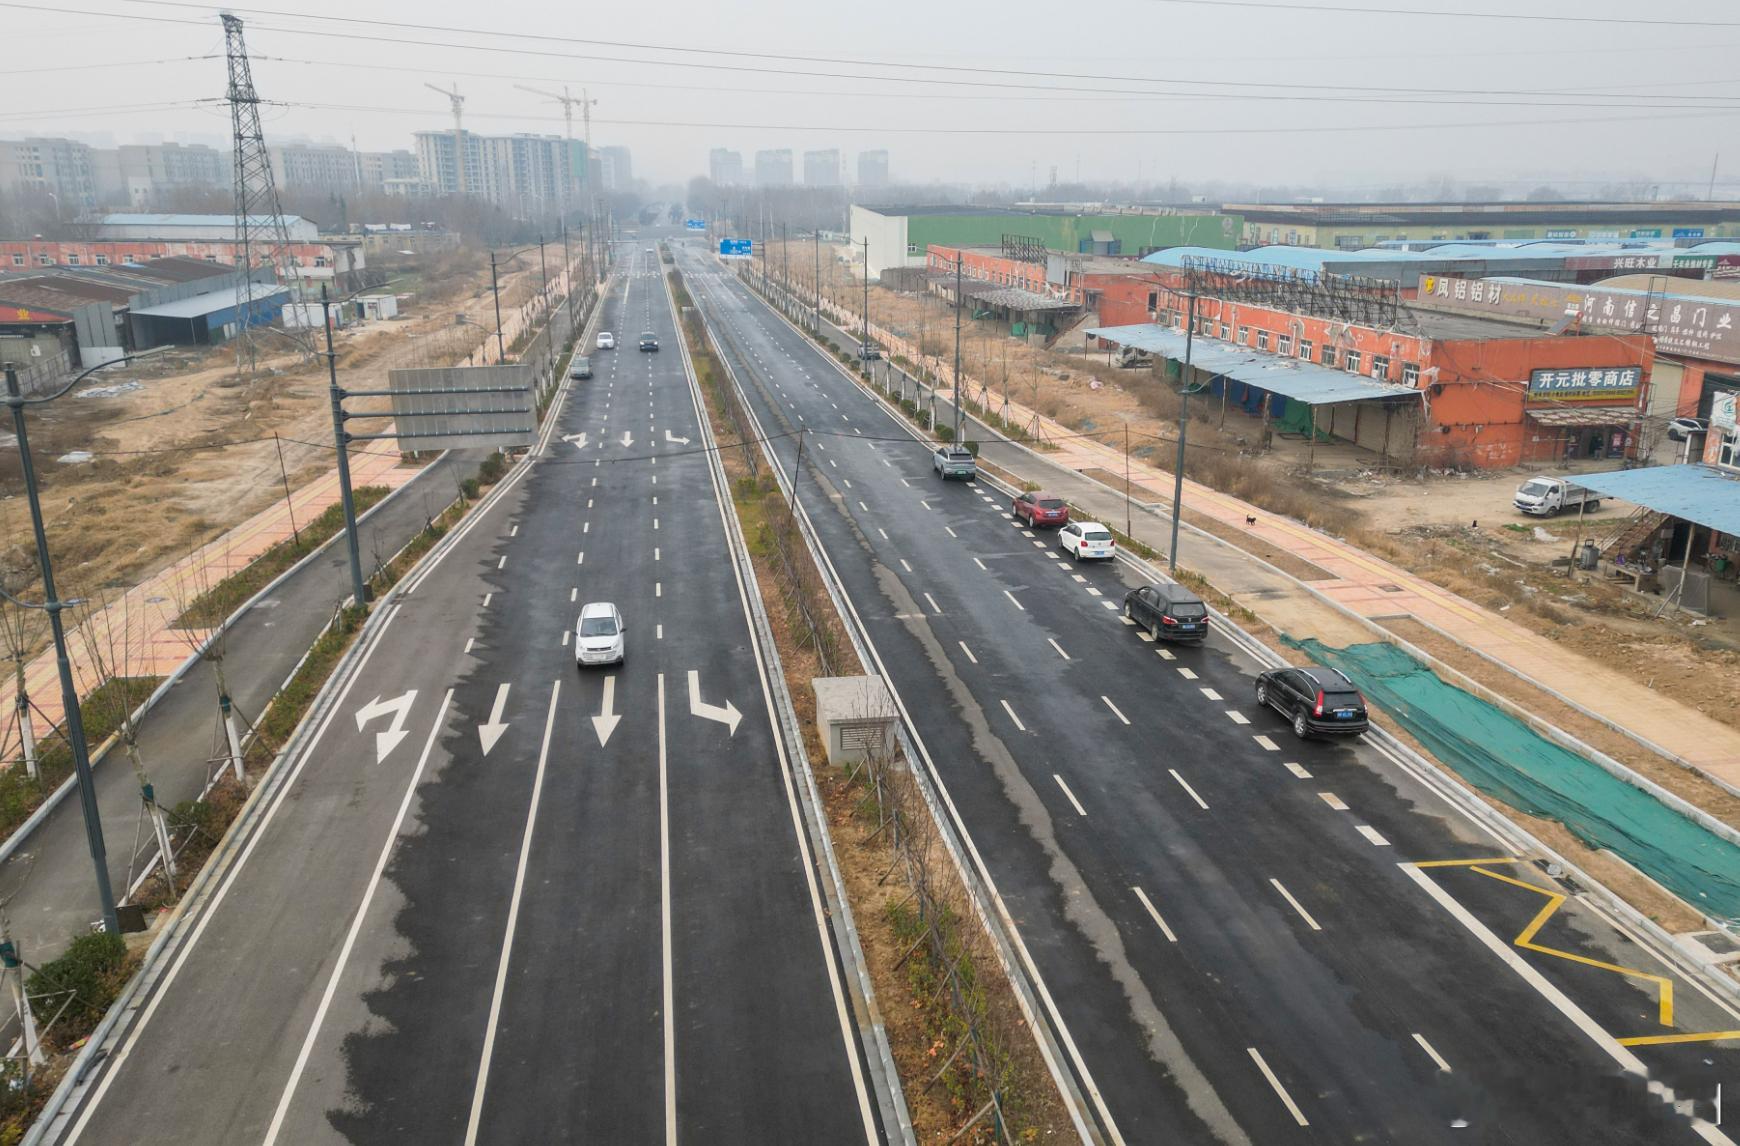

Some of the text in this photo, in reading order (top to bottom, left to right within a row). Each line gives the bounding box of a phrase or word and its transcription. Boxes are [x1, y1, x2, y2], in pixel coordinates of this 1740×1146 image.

[1613, 256, 1657, 268] 兴旺木业
[1437, 278, 1502, 305] 凤铝铝材
[1539, 370, 1635, 388] 开元批零商店
